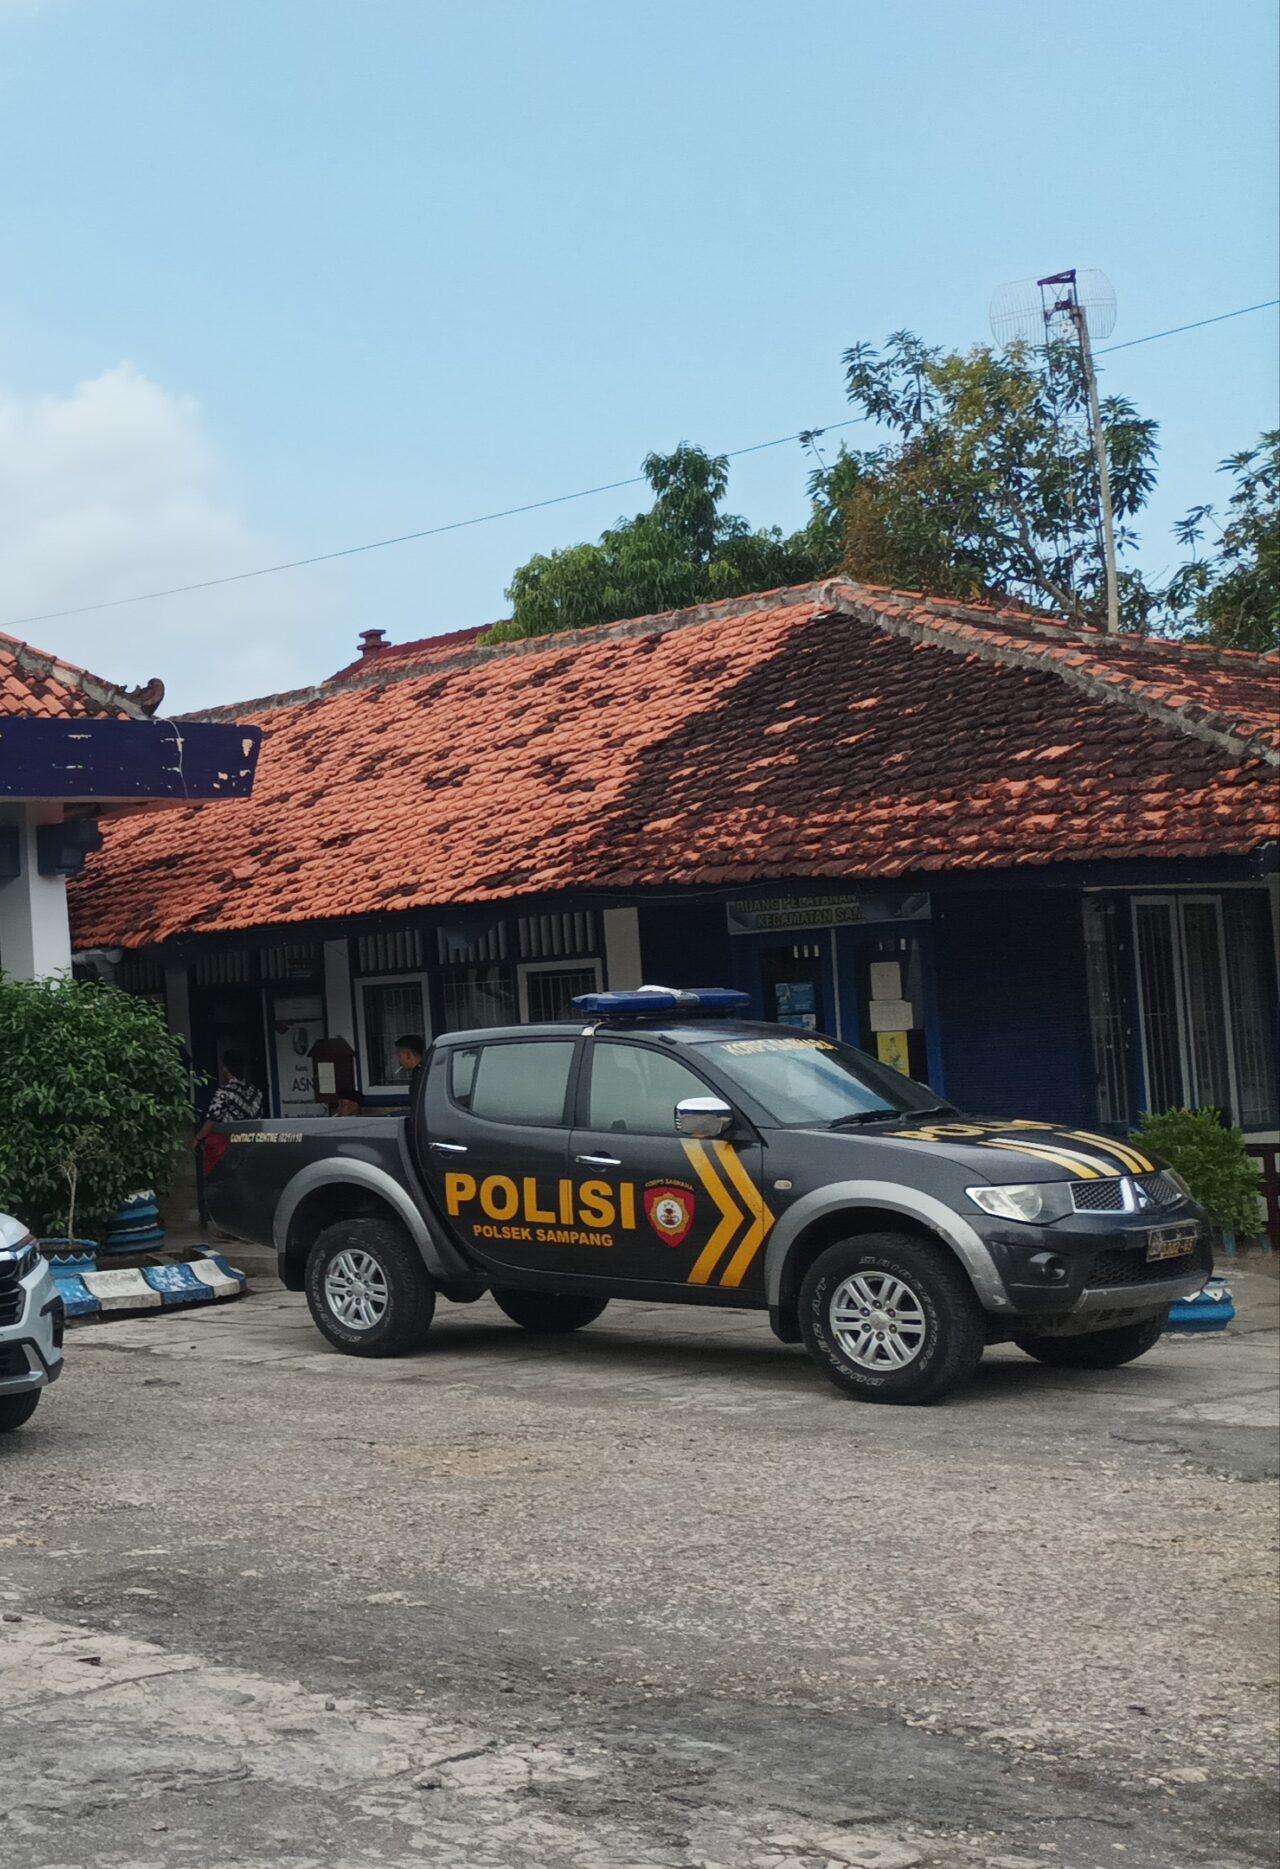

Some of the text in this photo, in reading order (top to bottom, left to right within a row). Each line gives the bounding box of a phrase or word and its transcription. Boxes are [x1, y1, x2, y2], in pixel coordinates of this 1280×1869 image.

[756, 909, 833, 927] KECAMATAN
[445, 1172, 636, 1230] POLISI
[472, 1224, 614, 1248] POLSEK SAMPANG
